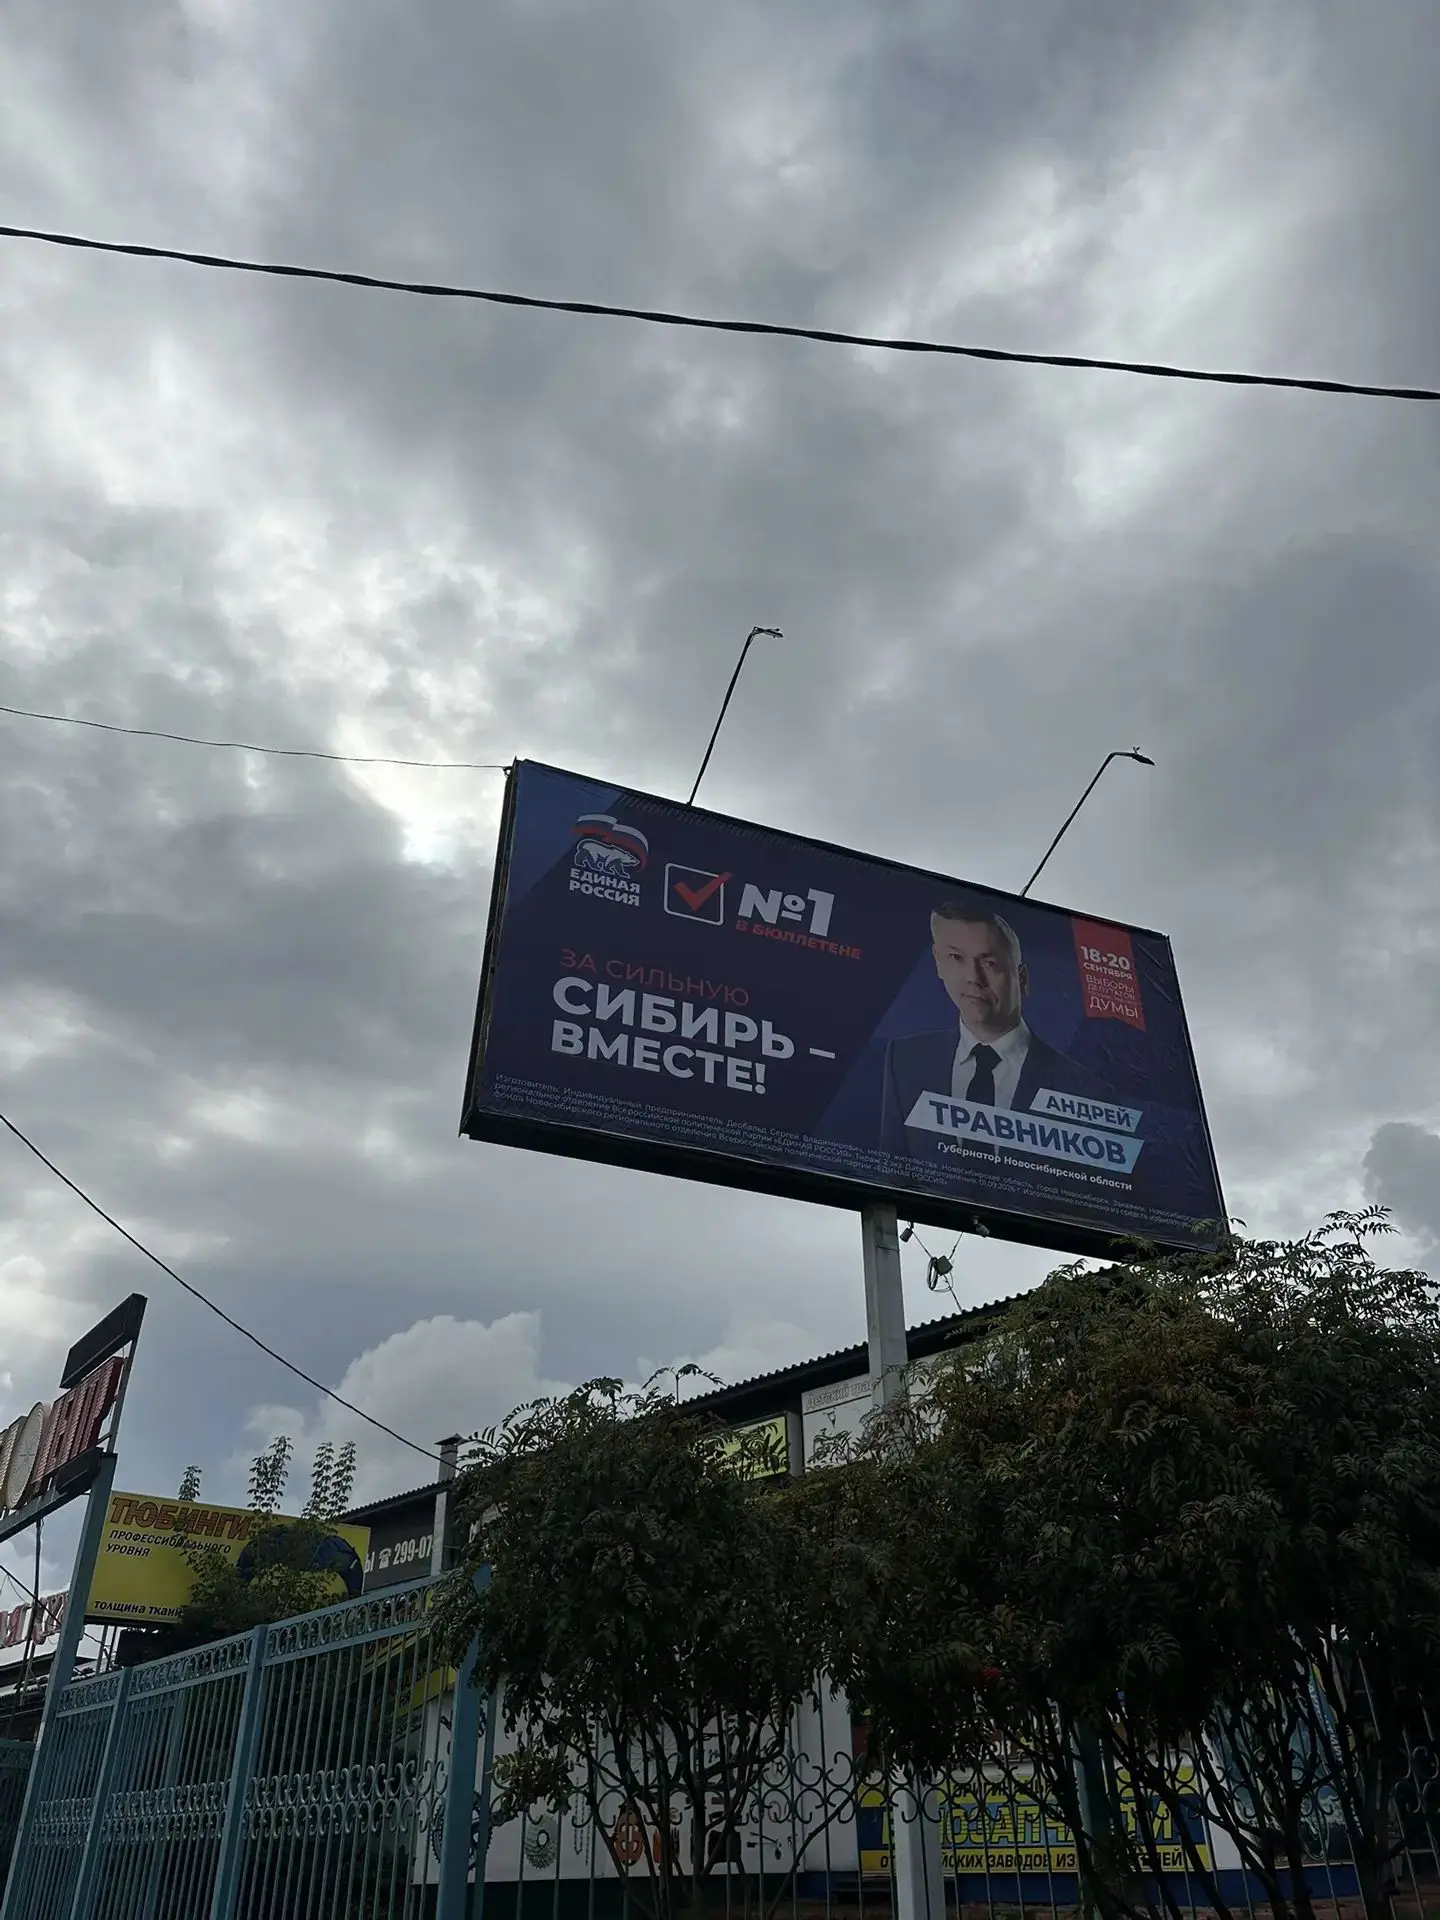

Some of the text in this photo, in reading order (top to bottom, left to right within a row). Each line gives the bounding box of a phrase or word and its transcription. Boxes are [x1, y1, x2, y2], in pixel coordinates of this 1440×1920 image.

[569, 880, 640, 908] РОССИЯ
[570, 868, 641, 895] ЕДИНАЯ
[737, 883, 835, 938] №1
[735, 919, 861, 960] В БЮЛЛЕТЕНЕ
[560, 948, 750, 1006] ЗА СИЛЬНУЮ
[1083, 962, 1133, 980] СЕНТЯБРЯ
[1086, 974, 1134, 993] ВЫБОРЫ
[552, 976, 795, 1060] СИБИРЬ
[1090, 996, 1139, 1018] ДУМЫ
[551, 1019, 768, 1095] ВМЕСТЕ!
[562, 1095, 609, 1110] отделение
[612, 1105, 679, 1124] Всероссийской
[681, 1118, 739, 1136] политической
[1046, 1095, 1132, 1127] АНДРЕЙ
[769, 1127, 798, 1140] Сергей
[929, 1100, 1126, 1165] ТРАВНИКОВ
[937, 1141, 1133, 1192] Губернатор Новосибирской области
[110, 1497, 252, 1541] ТЮБИНГИ
[105, 1543, 150, 1557] УРОВНЯ
[109, 1530, 231, 1554] ПРОФЕССИОНАЛЬНОГО
[987, 1852, 1049, 1869] ЗАВОДОВ
